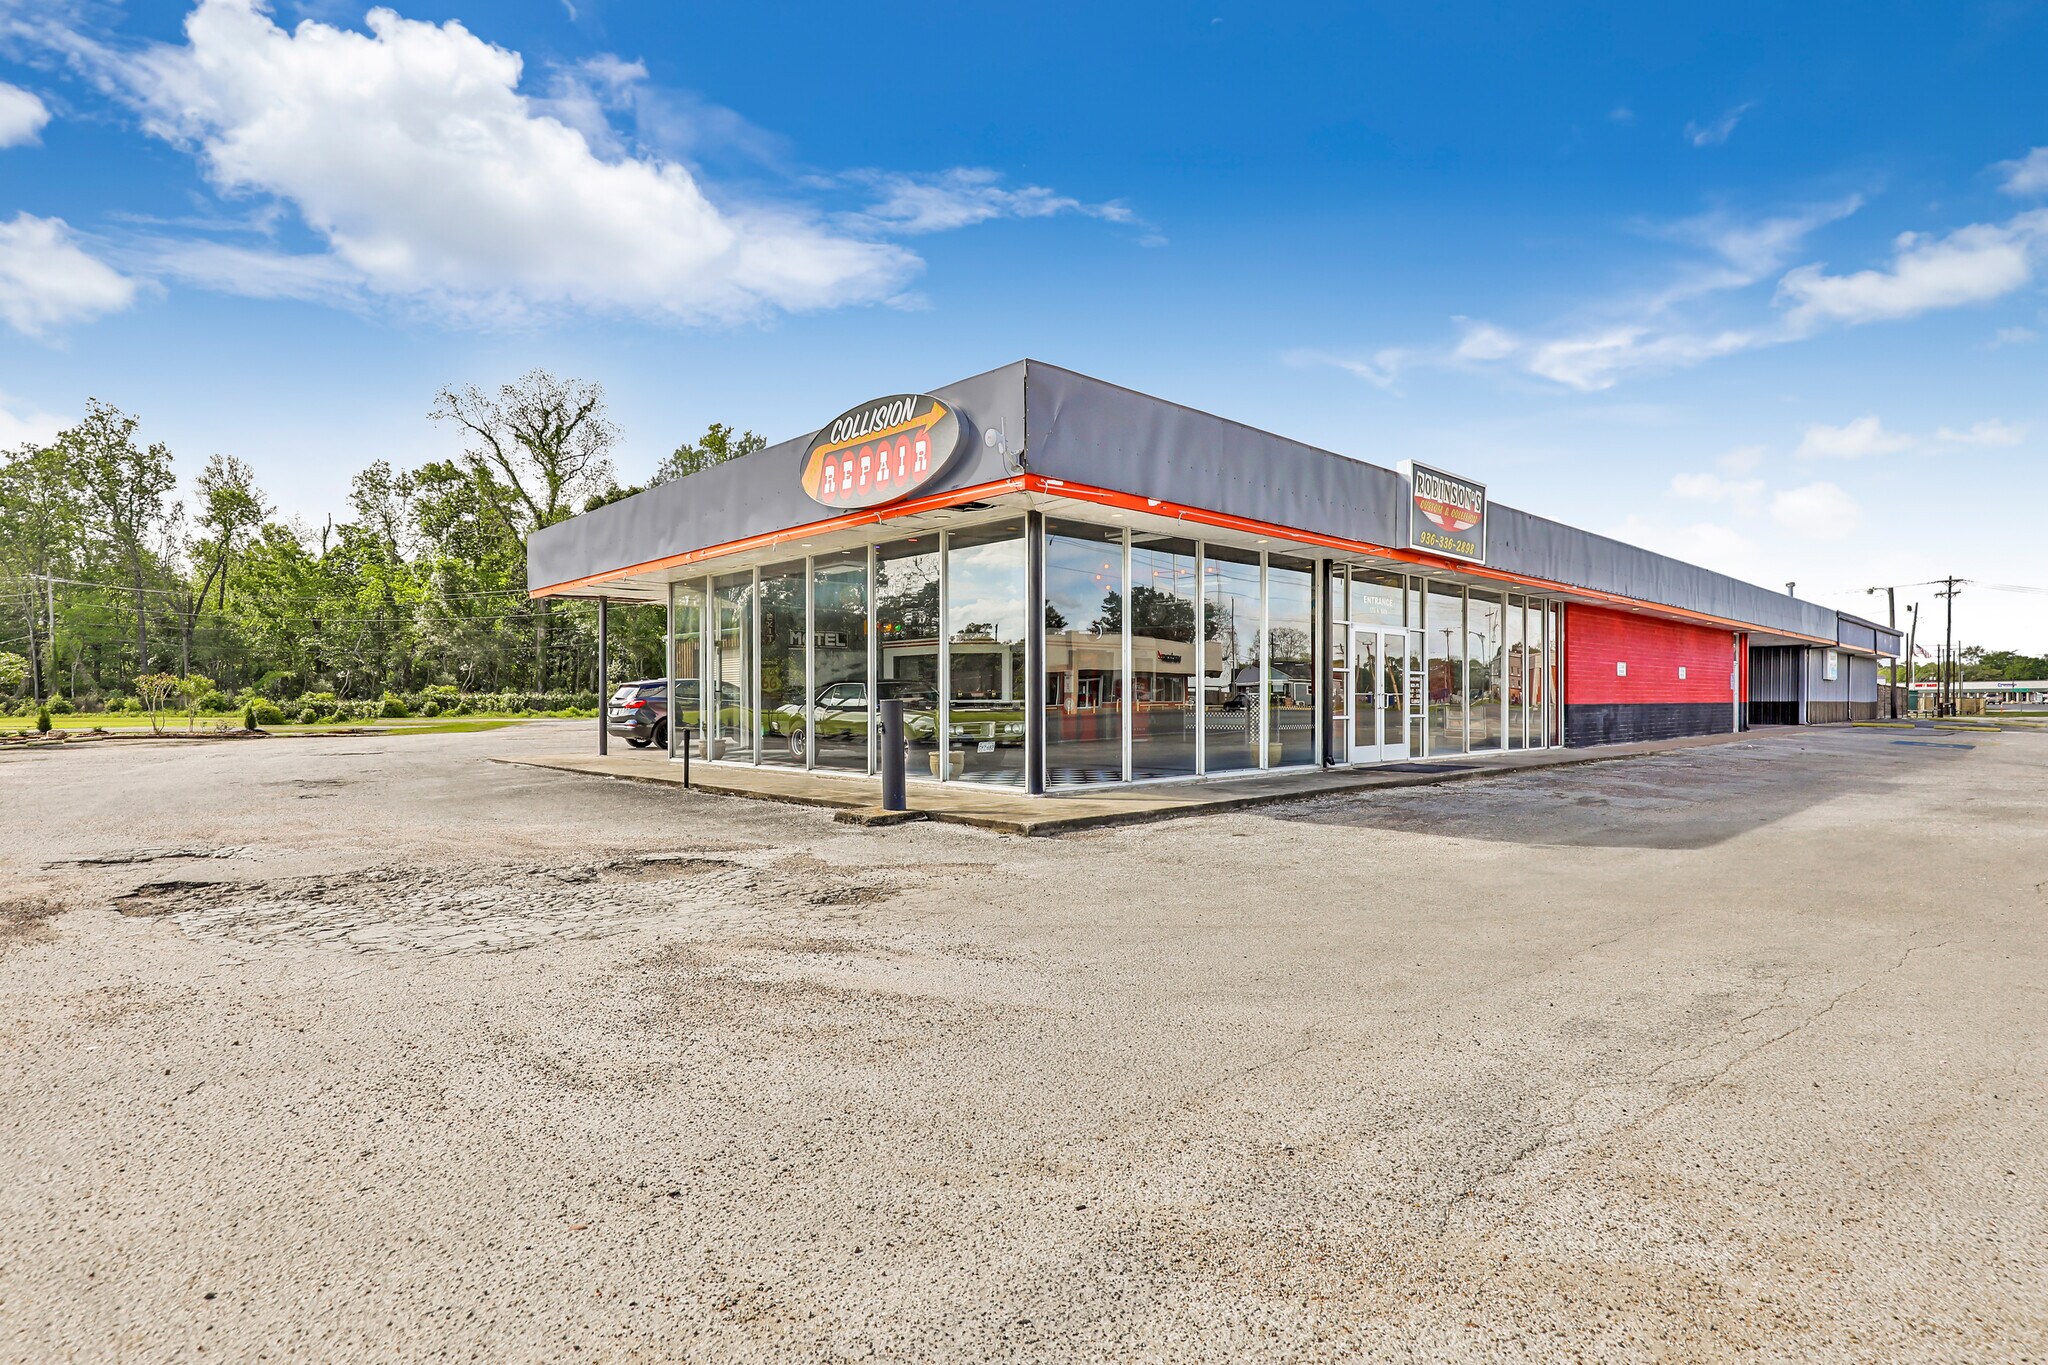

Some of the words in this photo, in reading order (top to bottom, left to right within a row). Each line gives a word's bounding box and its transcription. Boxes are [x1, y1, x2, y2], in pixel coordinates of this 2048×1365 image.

[830, 395, 918, 444] COLLISION
[824, 440, 927, 494] REPAIR
[1416, 472, 1481, 512] ROBINSON'S
[1420, 531, 1475, 555] 936-336-2898
[1363, 595, 1393, 607] ENTRANCE
